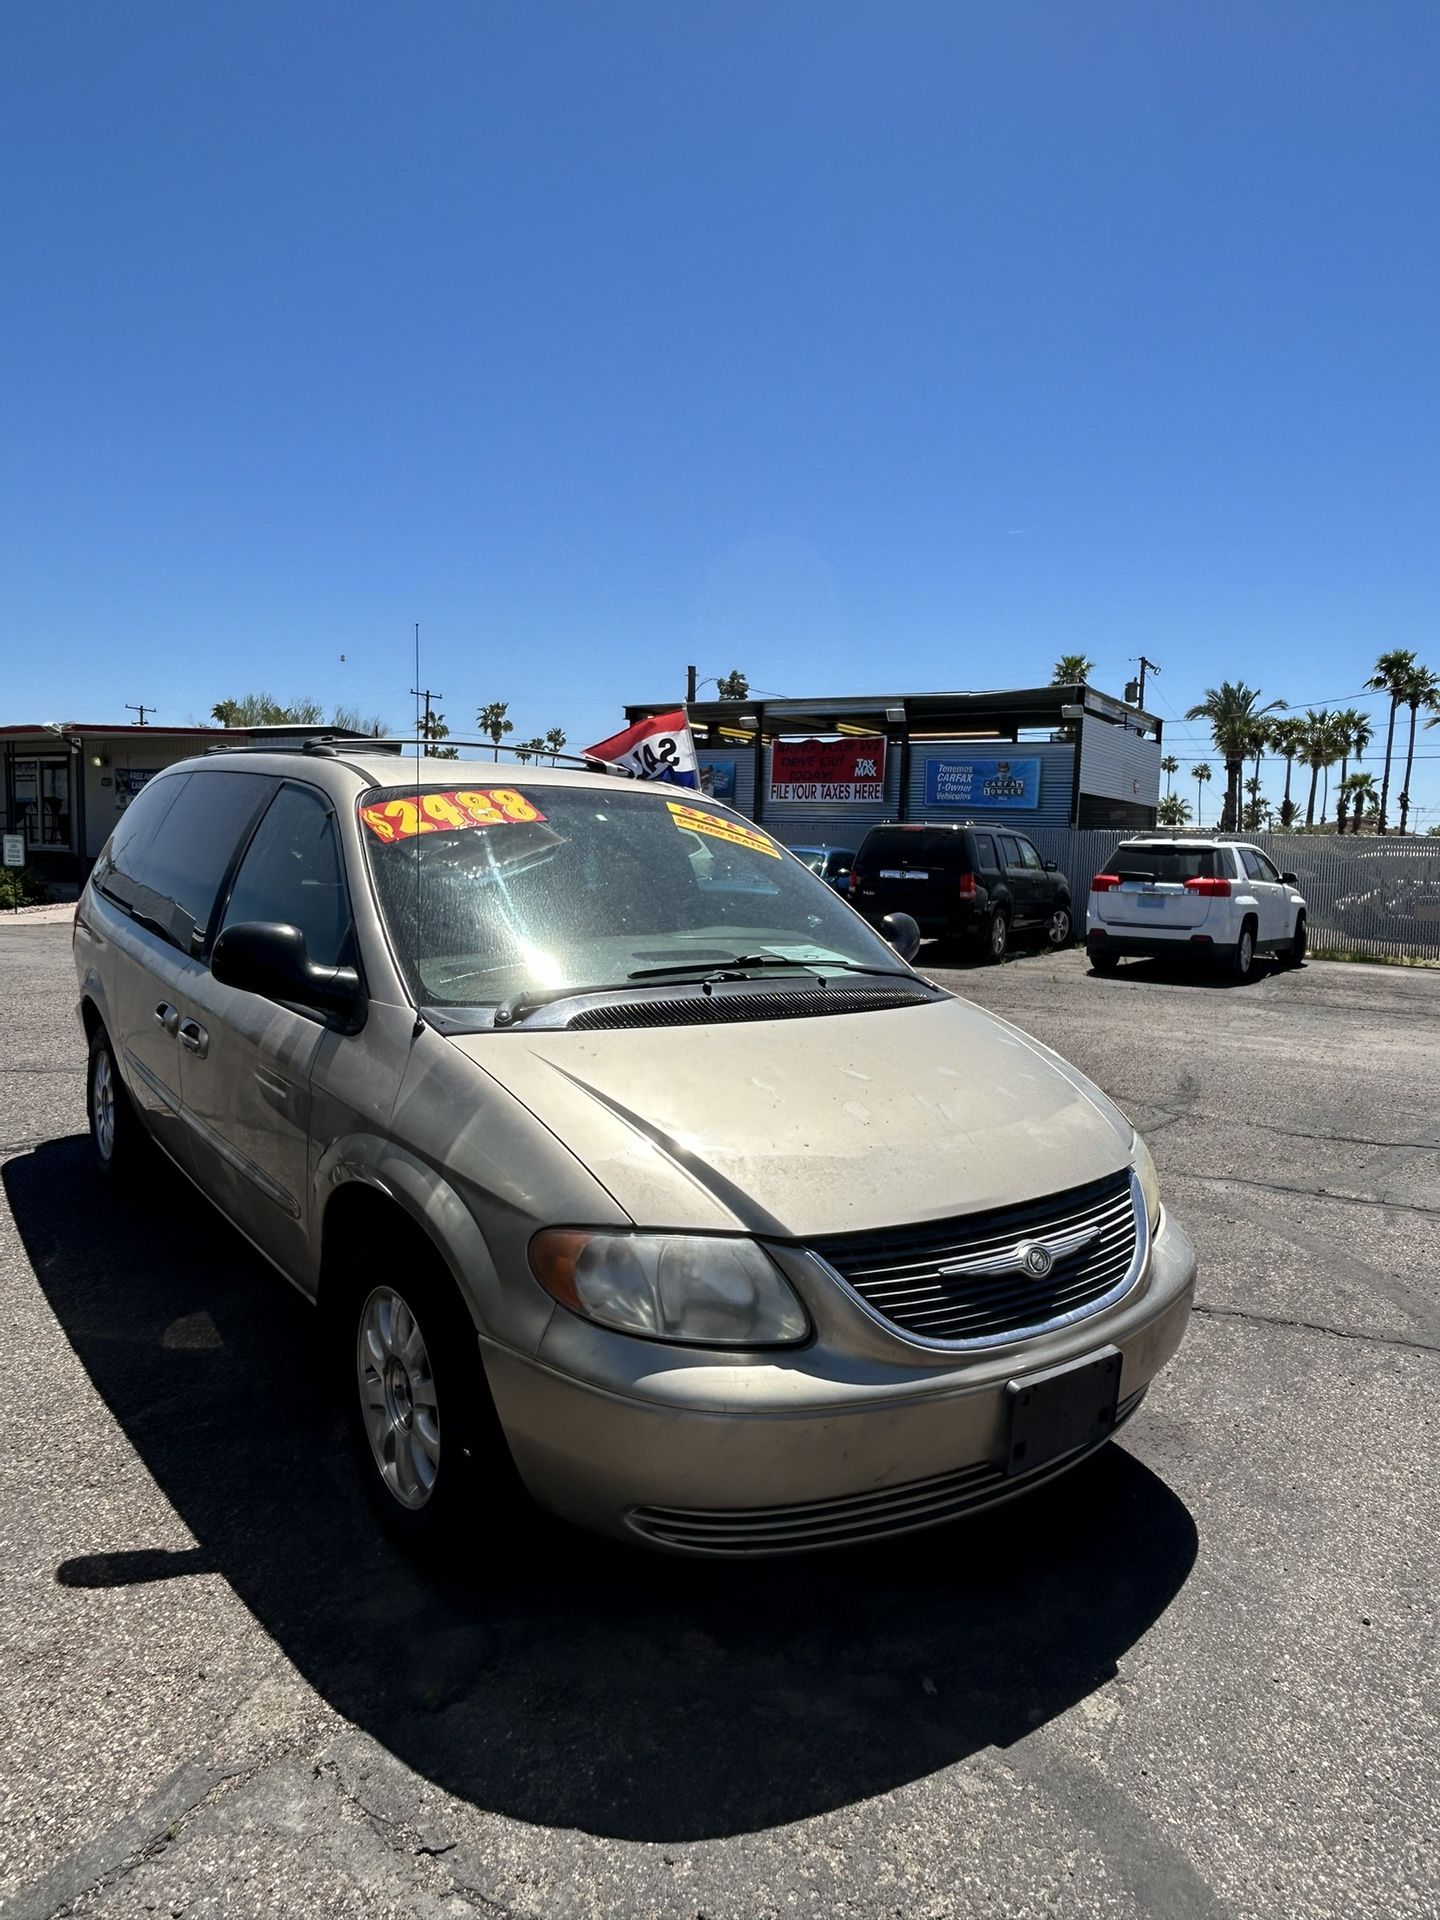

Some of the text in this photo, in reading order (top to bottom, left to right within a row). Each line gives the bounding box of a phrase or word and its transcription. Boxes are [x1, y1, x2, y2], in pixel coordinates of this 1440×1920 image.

[781, 756, 846, 767] DRIVE OUT
[856, 758, 875, 768] TAX
[854, 766, 877, 777] MAX
[939, 764, 973, 773] Tenemos
[937, 773, 973, 783] CARFAX
[771, 784, 883, 799] FILE YOUR TAXES HERE!
[937, 783, 972, 792] 1-Owner
[362, 790, 537, 839] $2488
